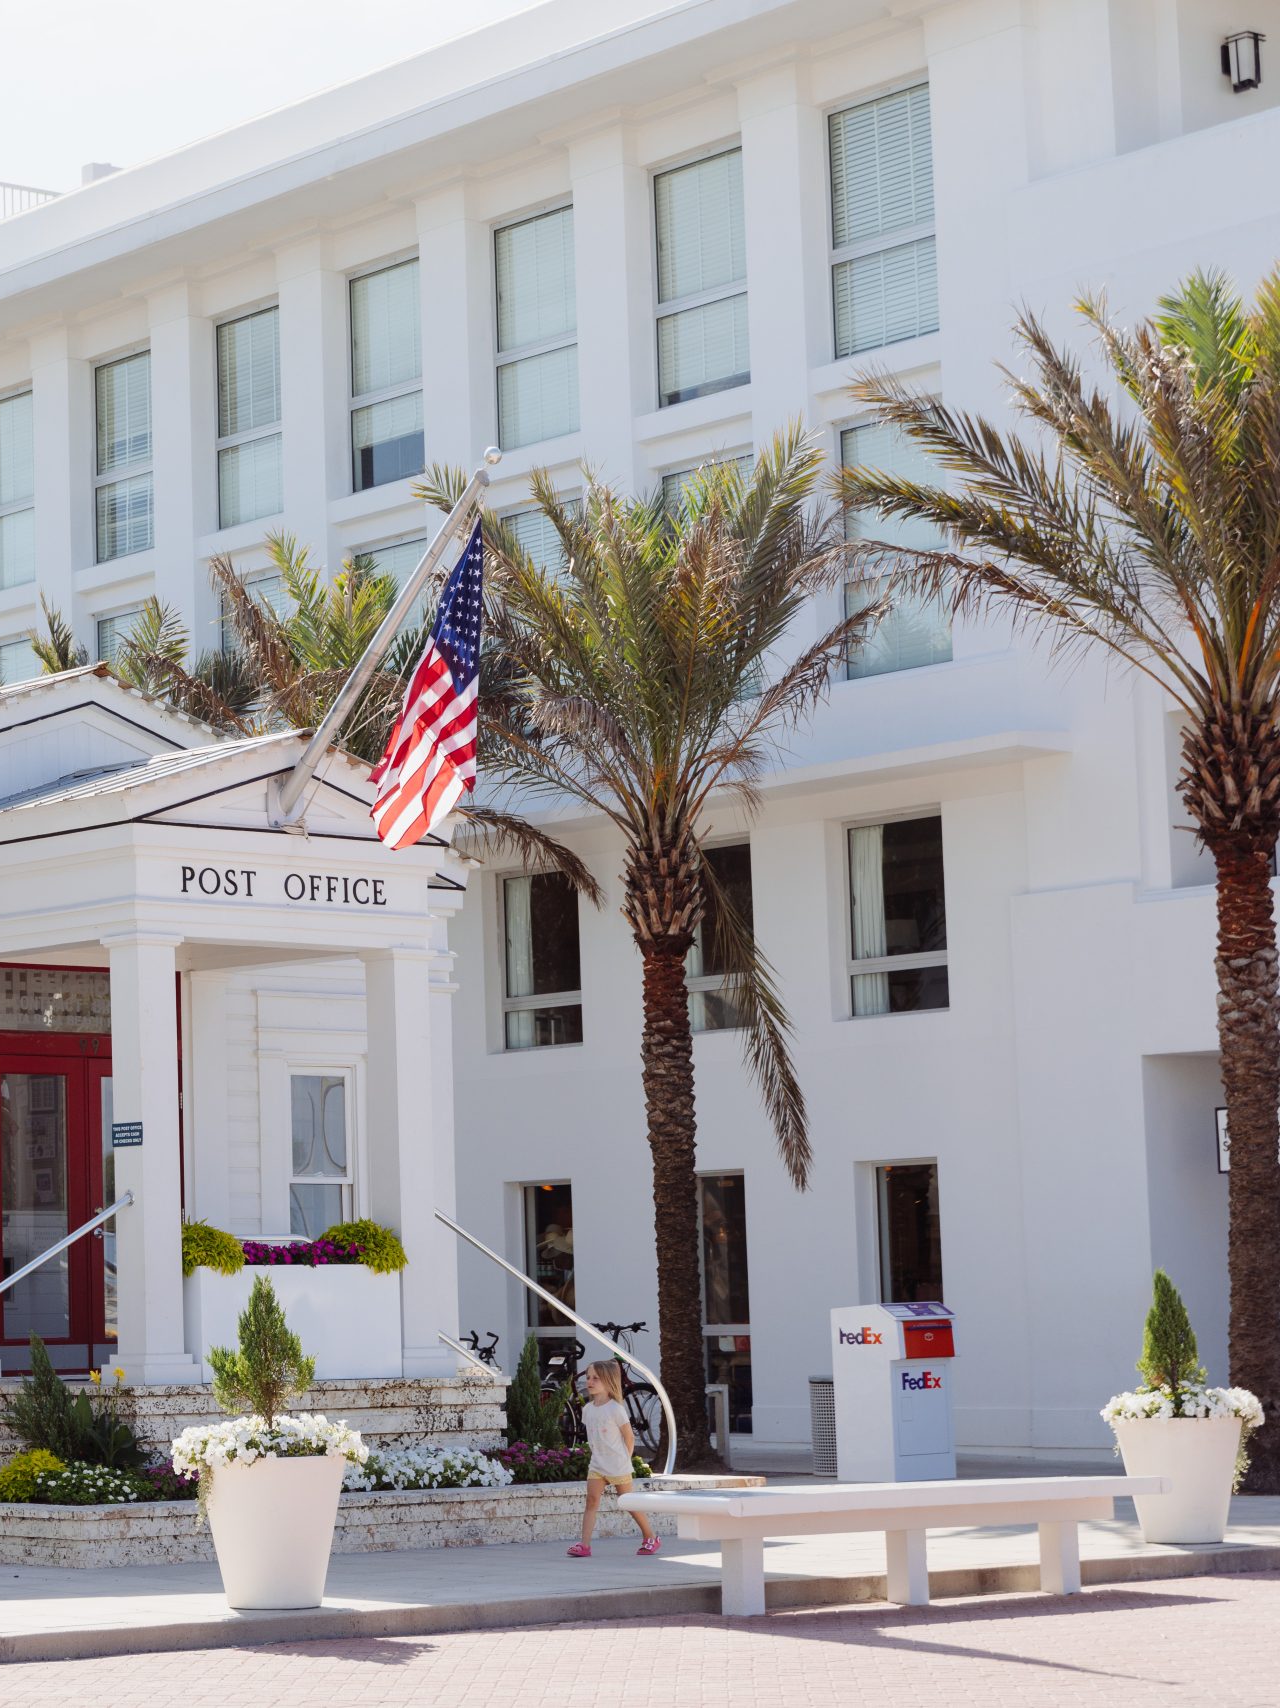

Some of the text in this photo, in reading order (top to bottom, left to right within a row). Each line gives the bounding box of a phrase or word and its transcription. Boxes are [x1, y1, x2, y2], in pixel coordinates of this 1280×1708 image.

[181, 866, 387, 906] POST OFFICE
[902, 1371, 942, 1390] FedEx
